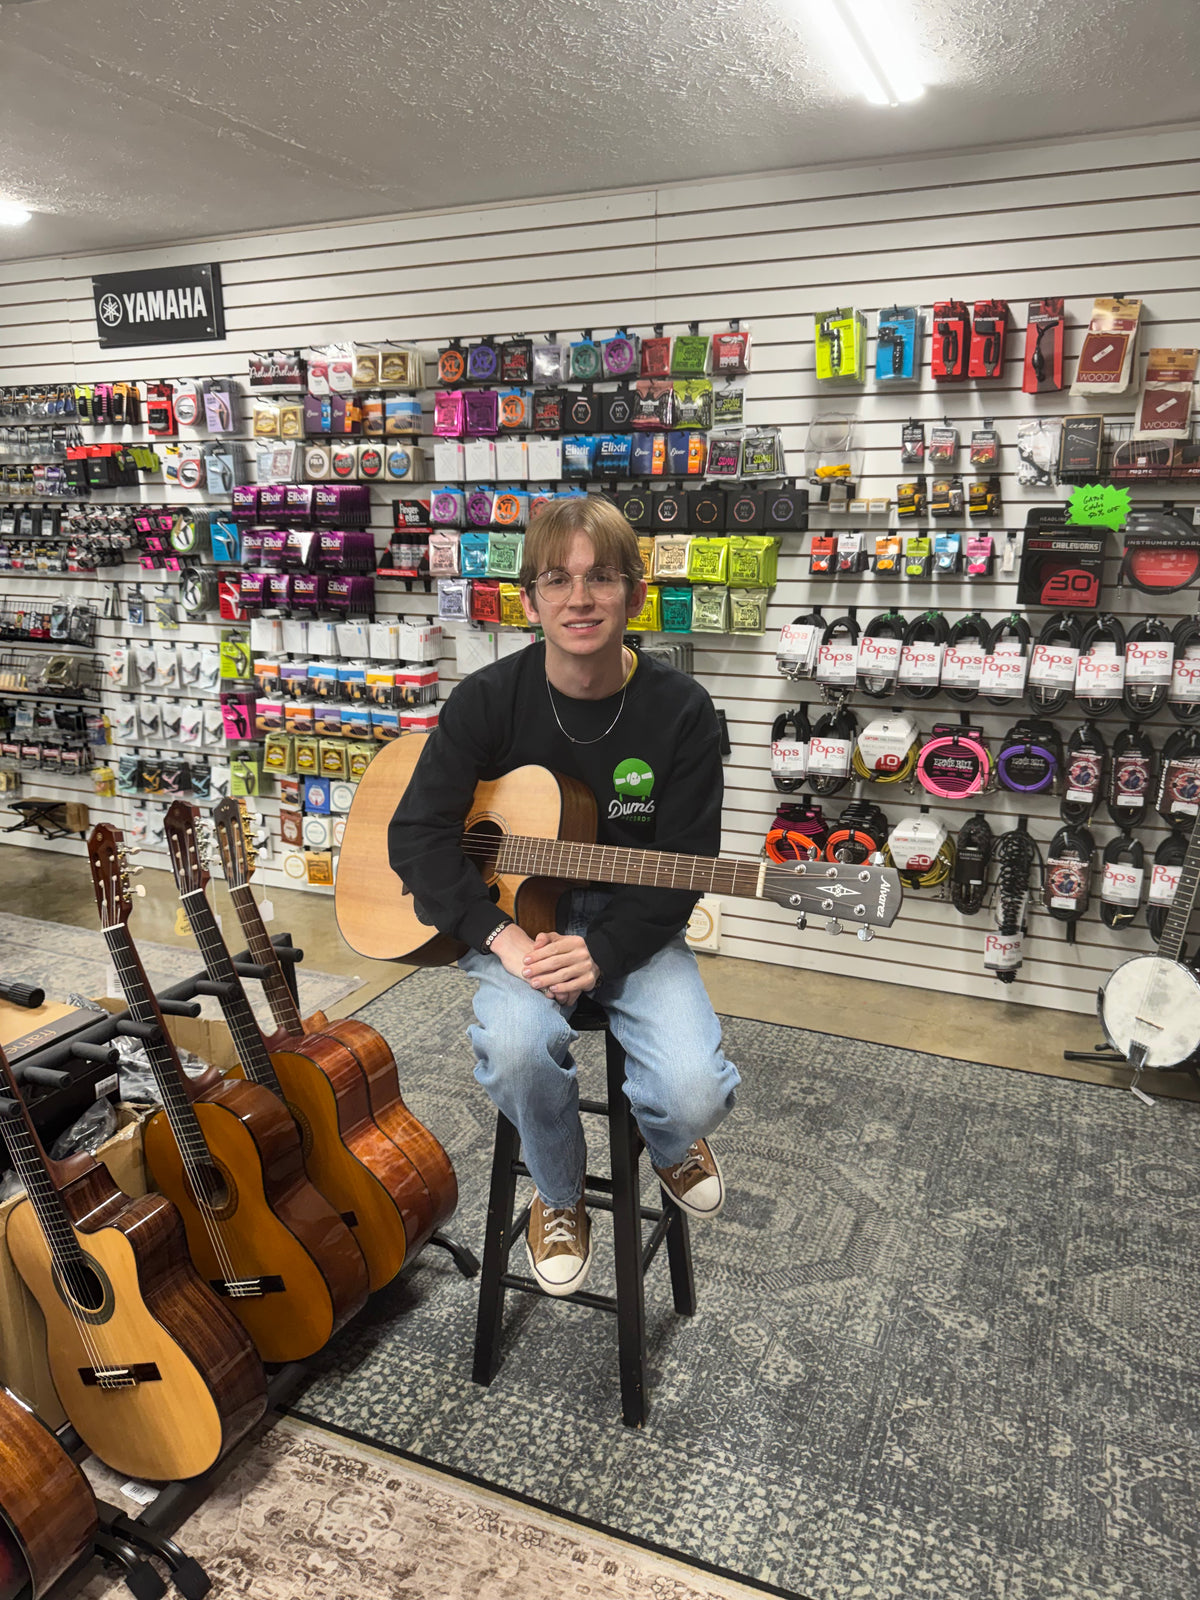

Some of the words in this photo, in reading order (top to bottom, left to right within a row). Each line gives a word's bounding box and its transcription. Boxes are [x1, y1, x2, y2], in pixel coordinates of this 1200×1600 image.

[122, 286, 208, 323] YAMAHA
[249, 365, 273, 379] Prelud
[1079, 373, 1118, 382] WOODY
[1143, 421, 1186, 430] WOODY
[601, 441, 628, 453] Elixir
[233, 492, 254, 503] Elixir
[260, 491, 282, 503] Elixir
[316, 491, 337, 502] Elixir
[263, 537, 283, 548] Elixir
[320, 536, 341, 548] Elixir
[1051, 542, 1099, 550] CABLEWORKS
[240, 579, 261, 590] Elixir
[294, 579, 315, 590] Elixir
[327, 580, 350, 593] Elixir
[1171, 660, 1200, 684] Pop
[607, 799, 656, 819] Dumb
[908, 855, 931, 866] 20
[1152, 865, 1180, 890] Pop
[876, 874, 892, 919] Alvarez
[4, 1028, 57, 1055] frame
